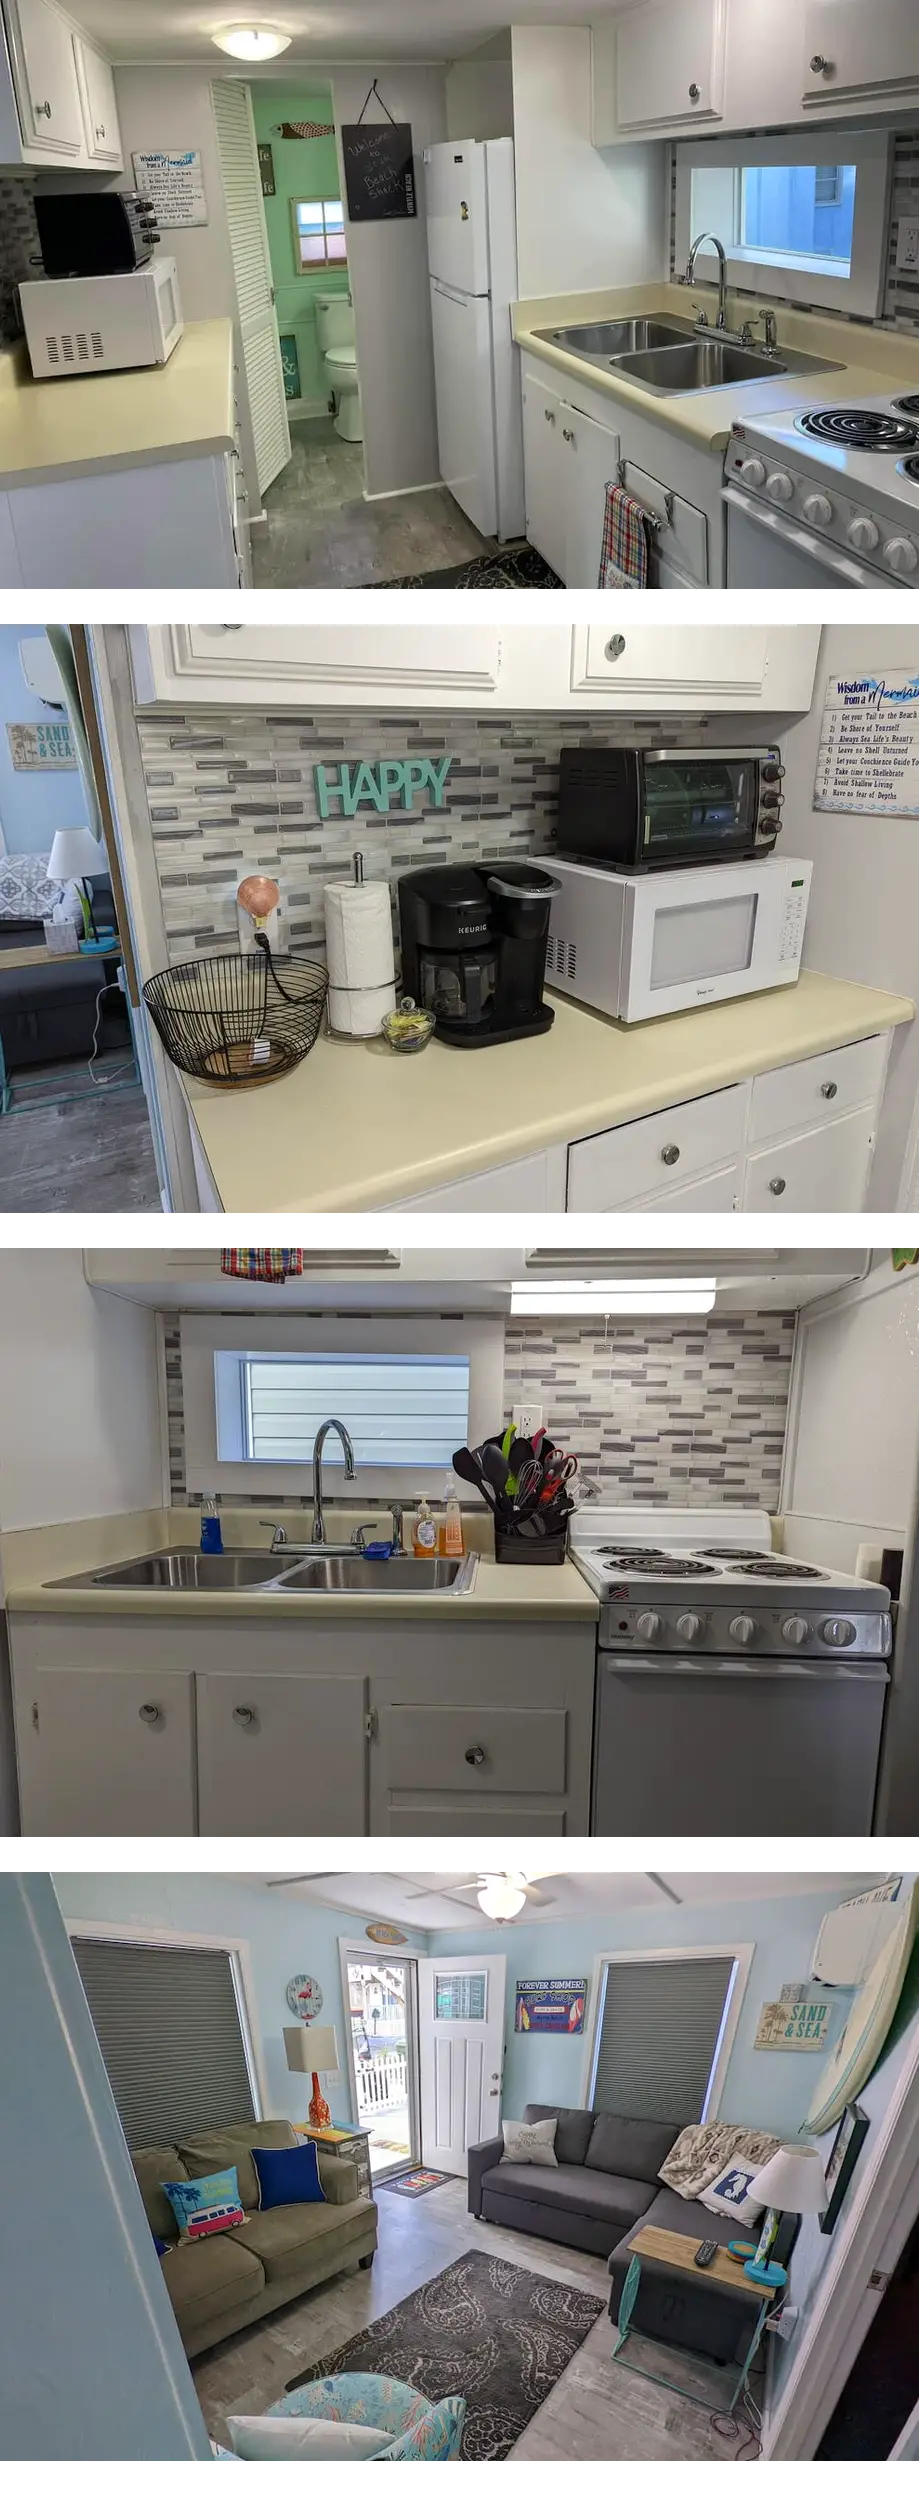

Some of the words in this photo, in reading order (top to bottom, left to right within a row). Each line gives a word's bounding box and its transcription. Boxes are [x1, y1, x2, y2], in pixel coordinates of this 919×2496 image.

[364, 166, 397, 190] Beach
[837, 680, 870, 694] Wisdom
[844, 694, 860, 705] from
[861, 696, 866, 704] a
[868, 681, 919, 711] Mermai
[851, 714, 862, 722] your
[866, 712, 877, 720] Tail
[879, 712, 885, 720] to
[887, 711, 897, 719] the
[899, 710, 917, 719] Beach
[841, 724, 847, 732] Be
[849, 724, 865, 732] Shore
[866, 724, 872, 732] of
[875, 723, 900, 732] Yourself
[37, 725, 70, 742] SAND
[839, 735, 859, 744] Always
[860, 735, 870, 743] Sea
[872, 735, 889, 743] Life's
[892, 734, 914, 744] Beauty
[39, 743, 47, 757] &
[49, 741, 73, 757] SEA
[837, 746, 853, 754] Leave
[865, 746, 880, 754] Shell
[845, 758, 857, 766] your
[893, 757, 910, 766] Guide
[911, 758, 919, 766] Yo
[835, 767, 849, 775] Take
[850, 768, 863, 776] time
[314, 756, 453, 818] HAPPY
[834, 778, 849, 786] Avoid
[851, 779, 873, 787] Shallow
[874, 780, 893, 789] Living
[878, 791, 897, 800] Depths
[458, 923, 487, 934] KEURIG
[518, 1981, 549, 1990] FOREVER
[790, 2004, 827, 2021] SAND
[784, 2022, 794, 2038] &
[795, 2022, 821, 2038] SEA
